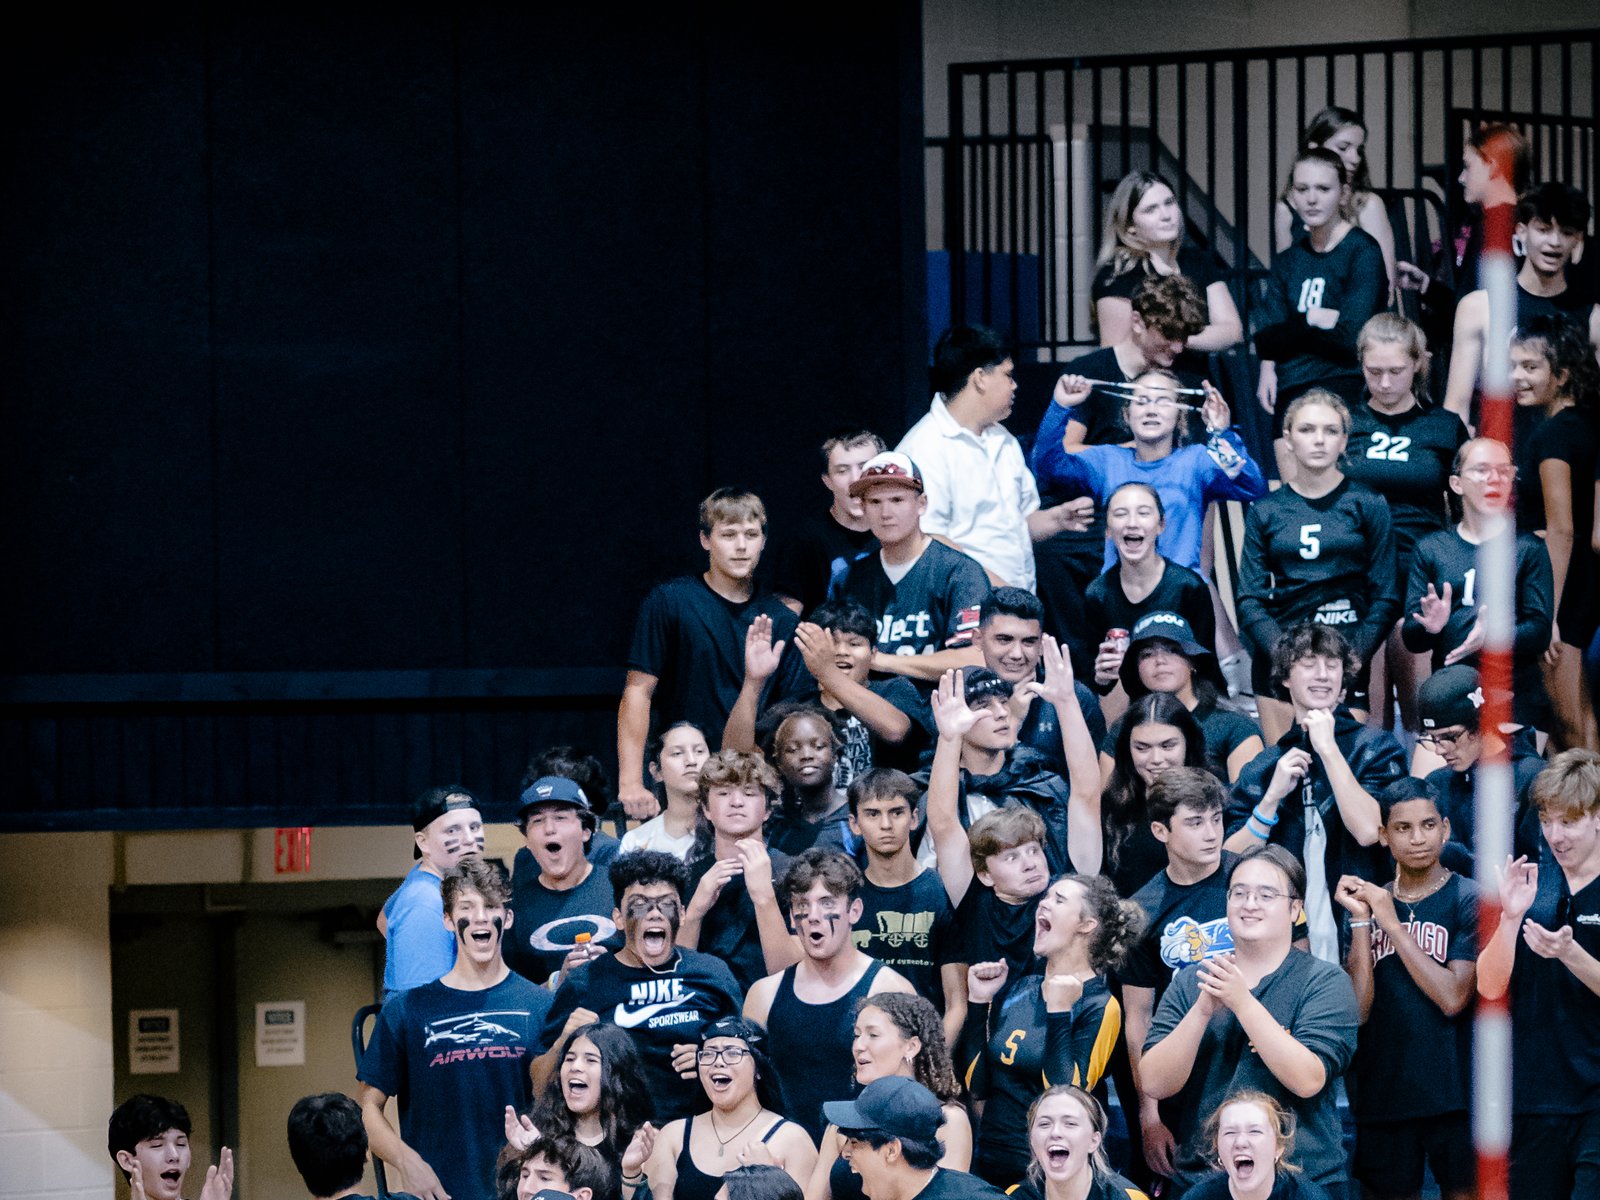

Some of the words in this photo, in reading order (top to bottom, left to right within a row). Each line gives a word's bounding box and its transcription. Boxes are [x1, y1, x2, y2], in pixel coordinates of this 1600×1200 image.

[1297, 277, 1326, 312] 18
[1366, 431, 1412, 462] 22
[1299, 523, 1322, 560] 5
[875, 610, 930, 644] lect
[1313, 609, 1358, 625] NIKE
[274, 827, 313, 874] EXIT
[628, 978, 684, 1006] NIKE
[648, 1010, 700, 1029] SPORTSWEAR
[429, 1046, 527, 1068] AIRWOLF
